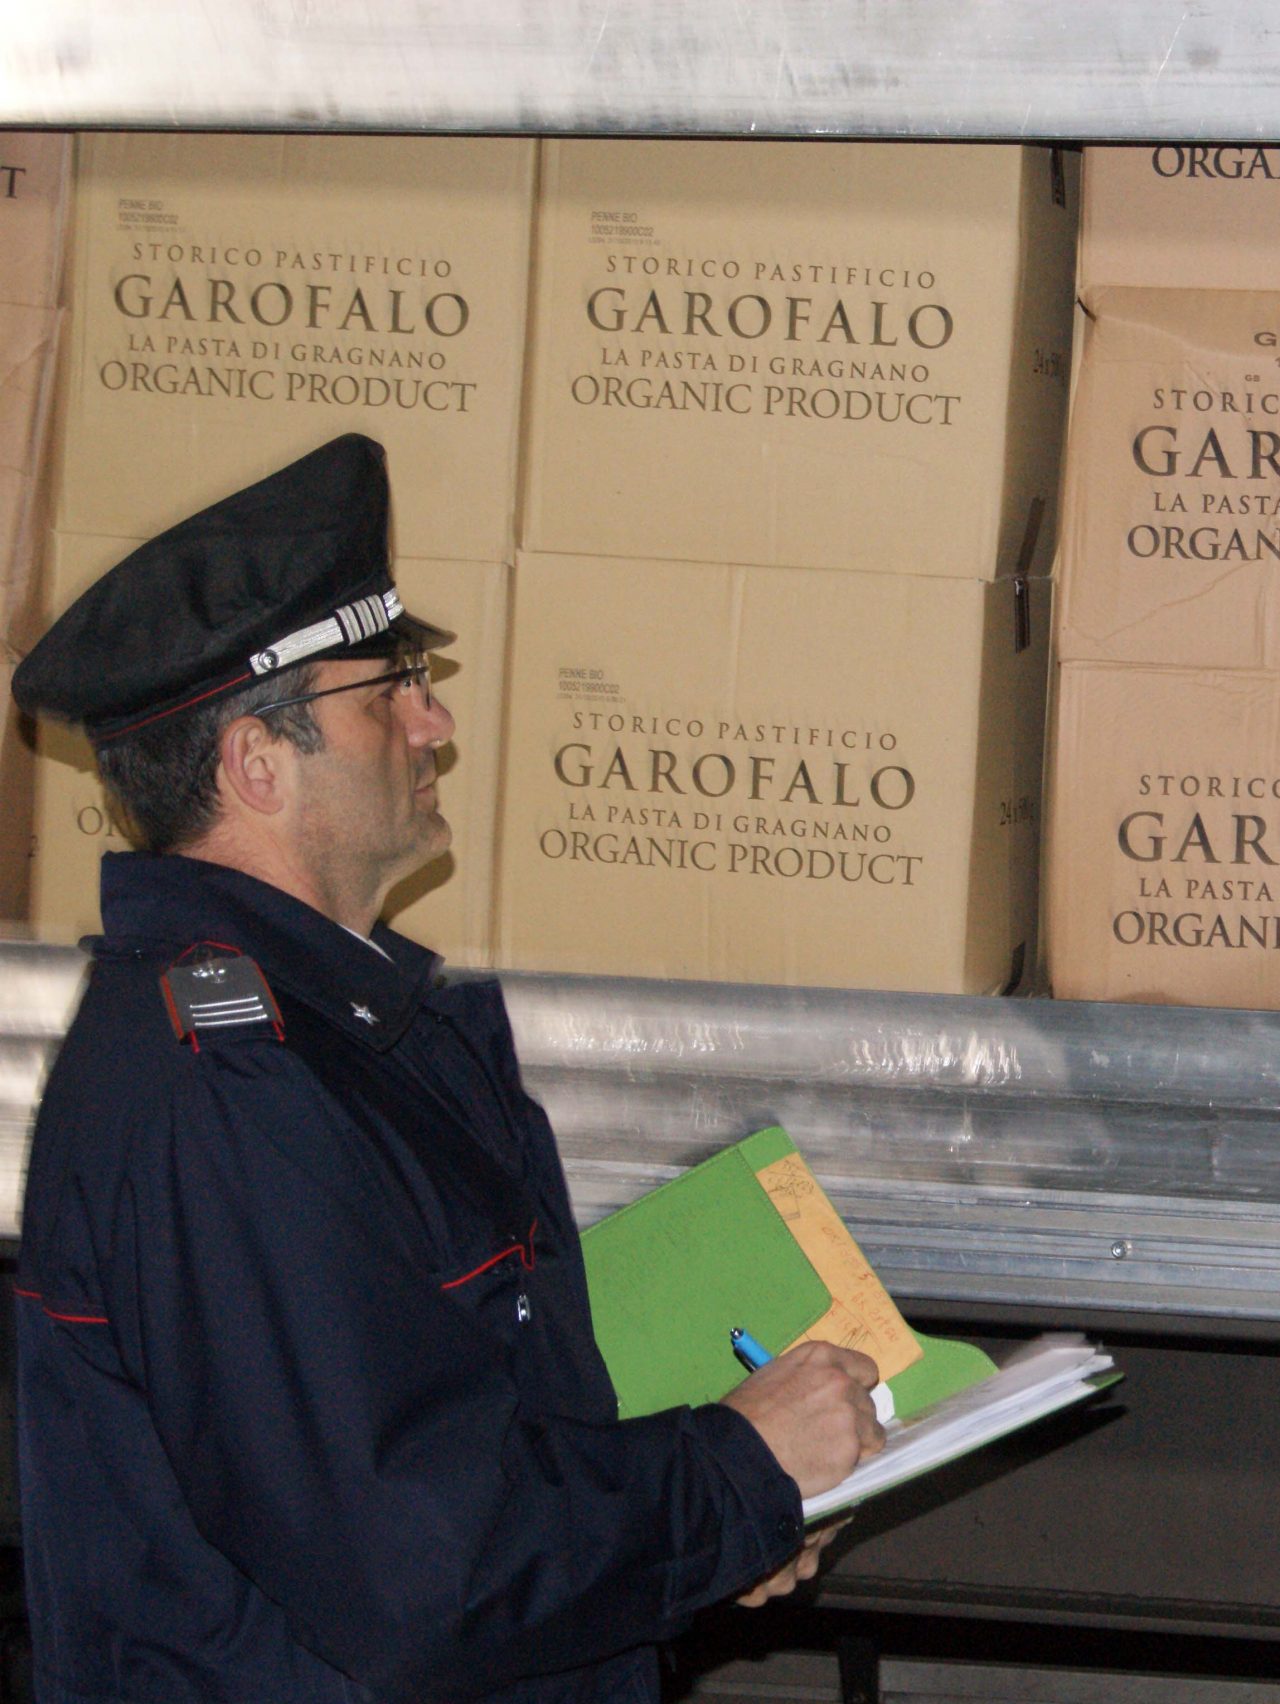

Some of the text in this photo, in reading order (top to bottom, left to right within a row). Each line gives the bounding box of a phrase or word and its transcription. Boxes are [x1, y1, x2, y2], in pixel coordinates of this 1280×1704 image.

[132, 242, 452, 278] STORICO PASTIFICIO
[606, 255, 935, 289] STORICO PASTIFICIO
[113, 274, 470, 337] GAROFALO
[586, 287, 954, 349] GAROFALO
[128, 334, 447, 370] LA PASTA DI GRAGNANO
[601, 347, 930, 383] LA PASTA DI GRAGNANO
[100, 361, 477, 413] ORGANIC PRODUCT
[571, 375, 962, 426] ORGANIC PRODUCT
[1153, 492, 1188, 514] LA
[573, 711, 898, 751] STORICO PASTIFICIO
[553, 743, 916, 811] GAROFALO
[569, 802, 891, 843] LA PASTA DI GRAGNANO
[539, 828, 923, 886] ORGANIC PRODUCT
[1139, 877, 1173, 899] LA
[1186, 880, 1274, 903] PASTA
